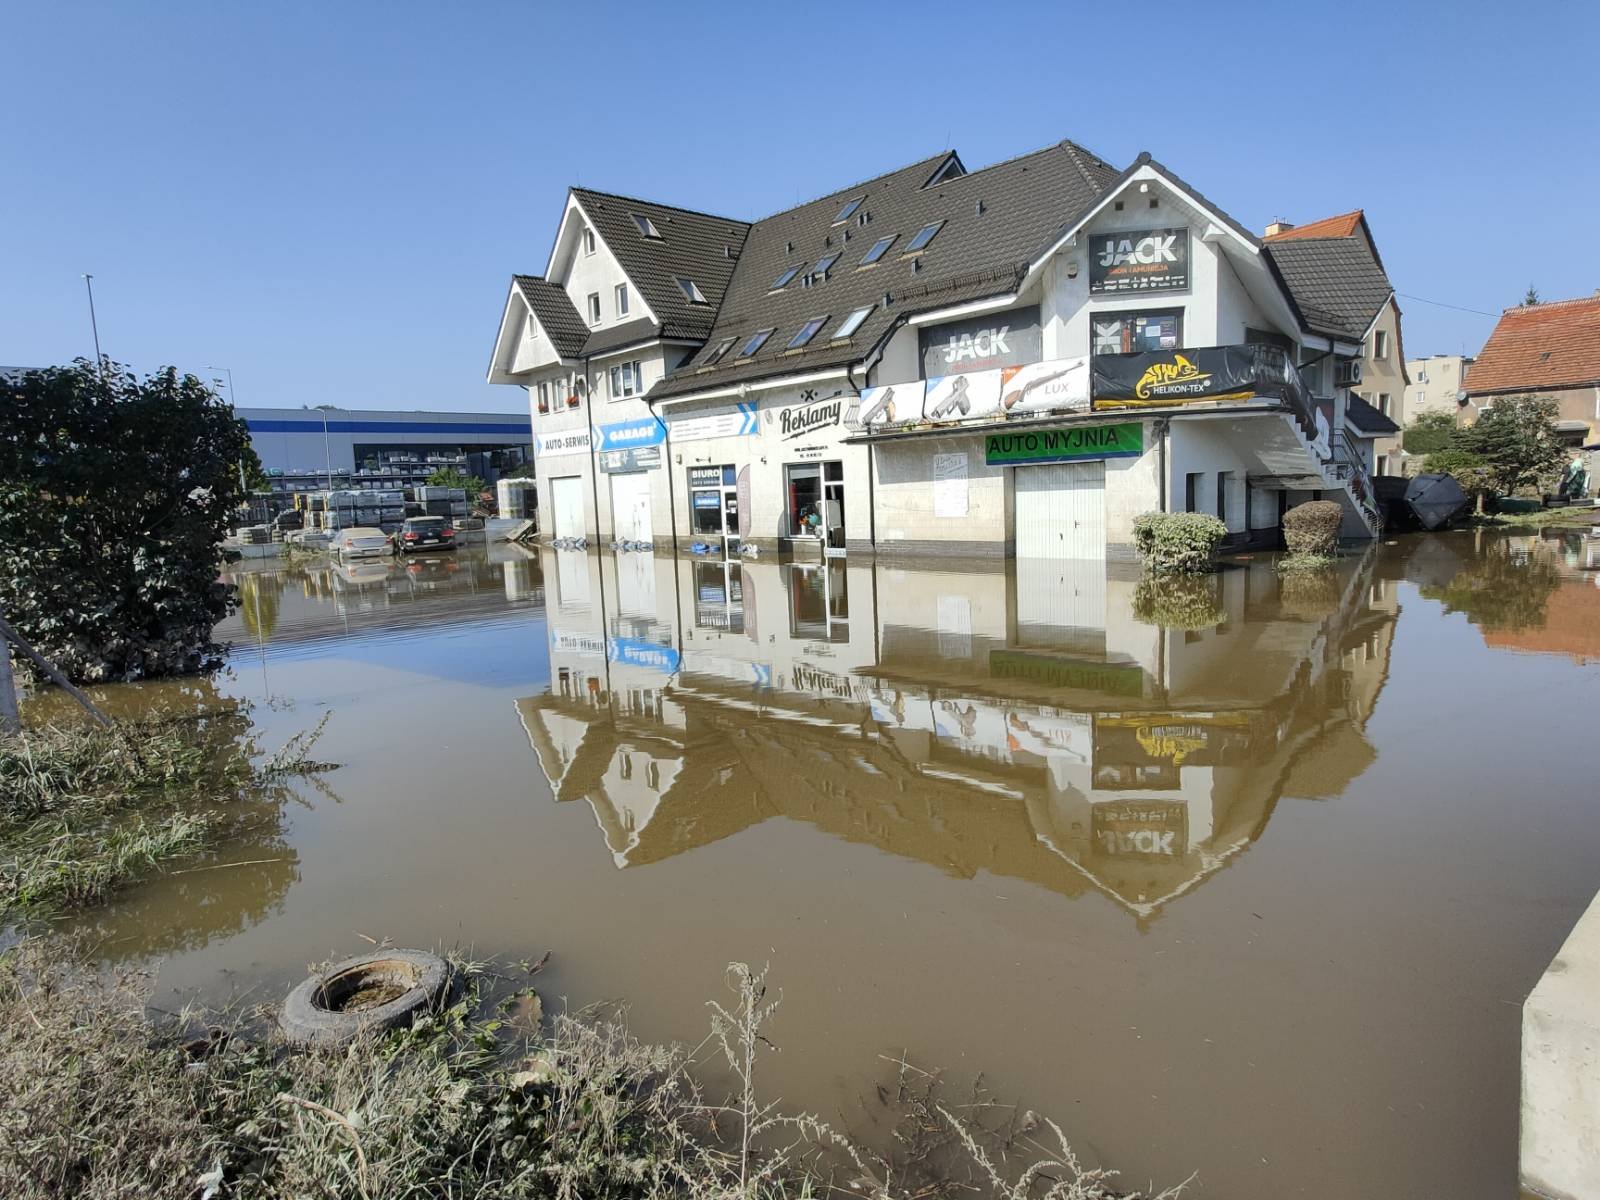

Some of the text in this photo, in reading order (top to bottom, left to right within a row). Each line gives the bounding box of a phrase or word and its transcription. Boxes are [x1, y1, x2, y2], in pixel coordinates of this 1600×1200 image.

[1100, 235, 1177, 266] JACK
[944, 325, 1011, 363] JACK
[1044, 383, 1069, 395] LUX
[779, 401, 841, 434] Reklamy
[545, 434, 590, 451] AUTO-SERWIS
[988, 427, 1119, 454] AUTO MYJNIA
[692, 468, 720, 479] BIURO
